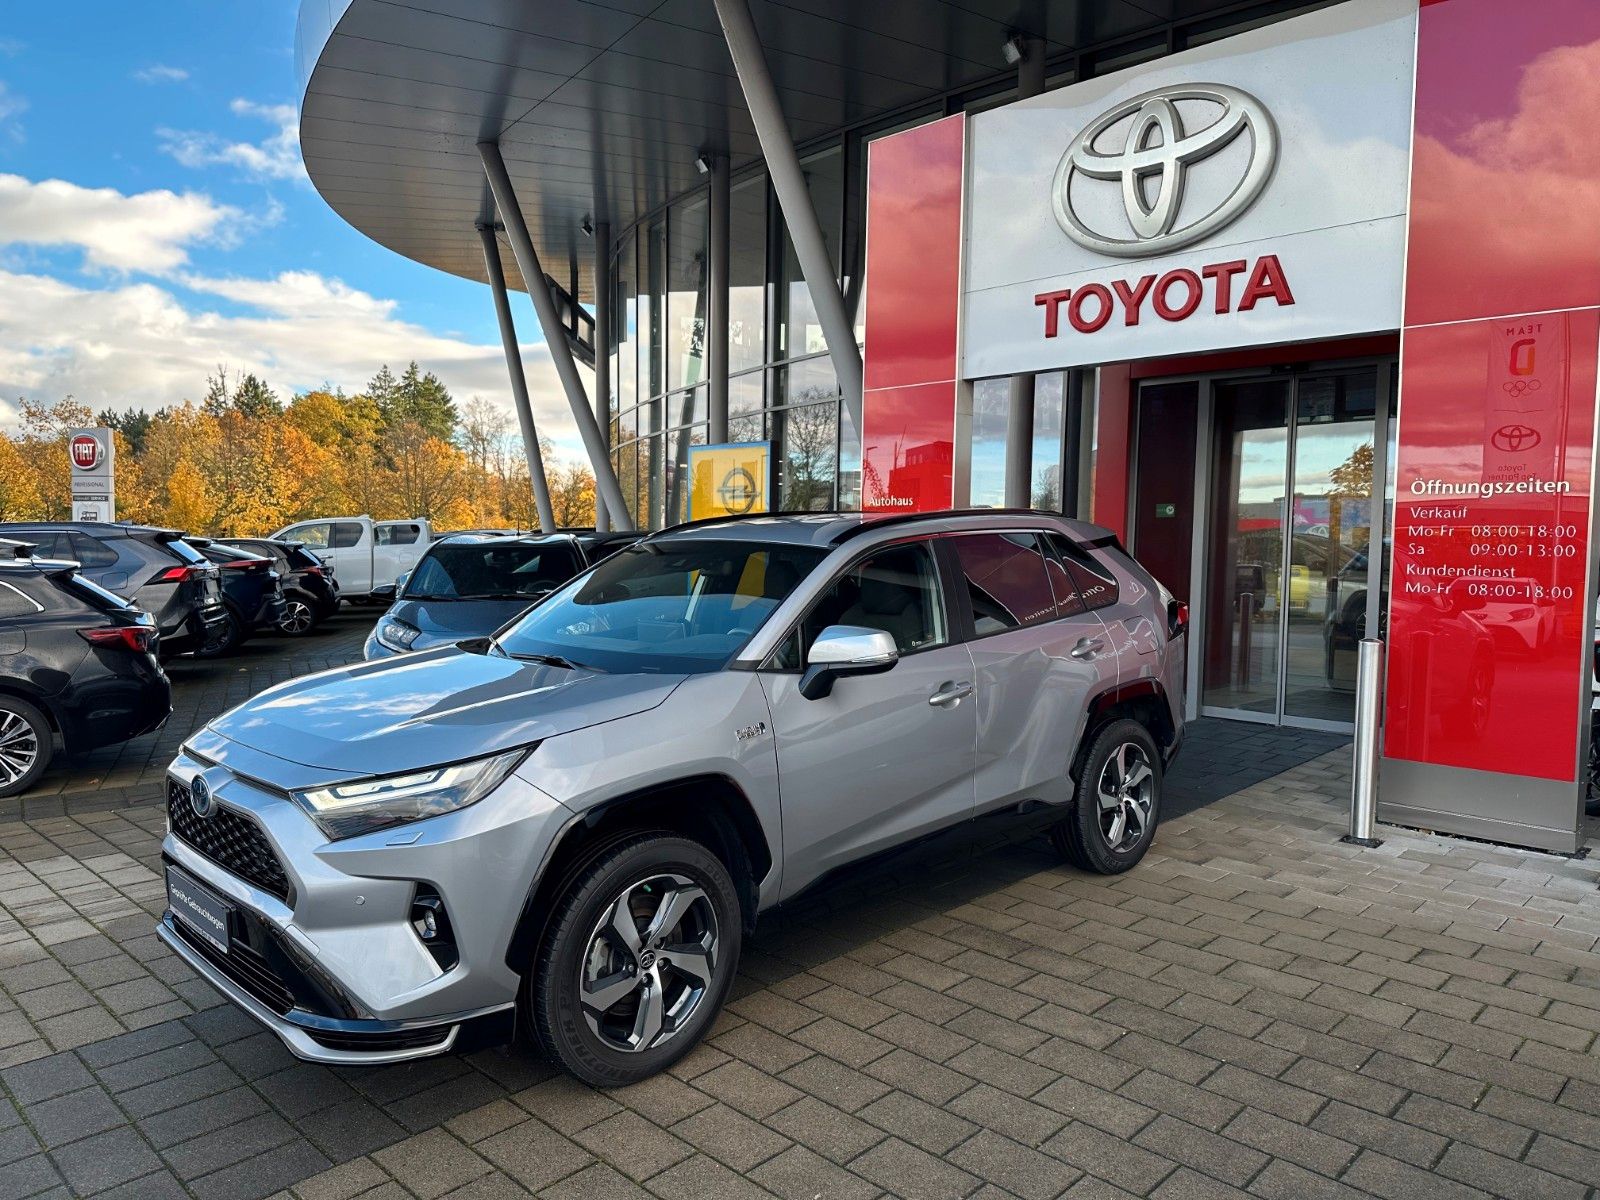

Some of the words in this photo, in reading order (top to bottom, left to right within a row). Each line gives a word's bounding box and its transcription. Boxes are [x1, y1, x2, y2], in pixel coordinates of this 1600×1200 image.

[1035, 254, 1295, 338] TOYOTA
[74, 443, 94, 461] FIAT
[1411, 477, 1570, 498] Öffnungszeiten
[869, 494, 913, 506] Autohaus
[1411, 506, 1467, 519] Verkauf
[1408, 525, 1454, 537] Mo-Fr
[1471, 525, 1577, 538] 08:00-18:00
[1408, 543, 1425, 555] Sa
[1470, 543, 1576, 557] 09:00-13:00
[1406, 563, 1516, 578] Kundendienst
[1405, 582, 1451, 594] Mo-Fr
[1468, 583, 1573, 599] 08:00-18:00
